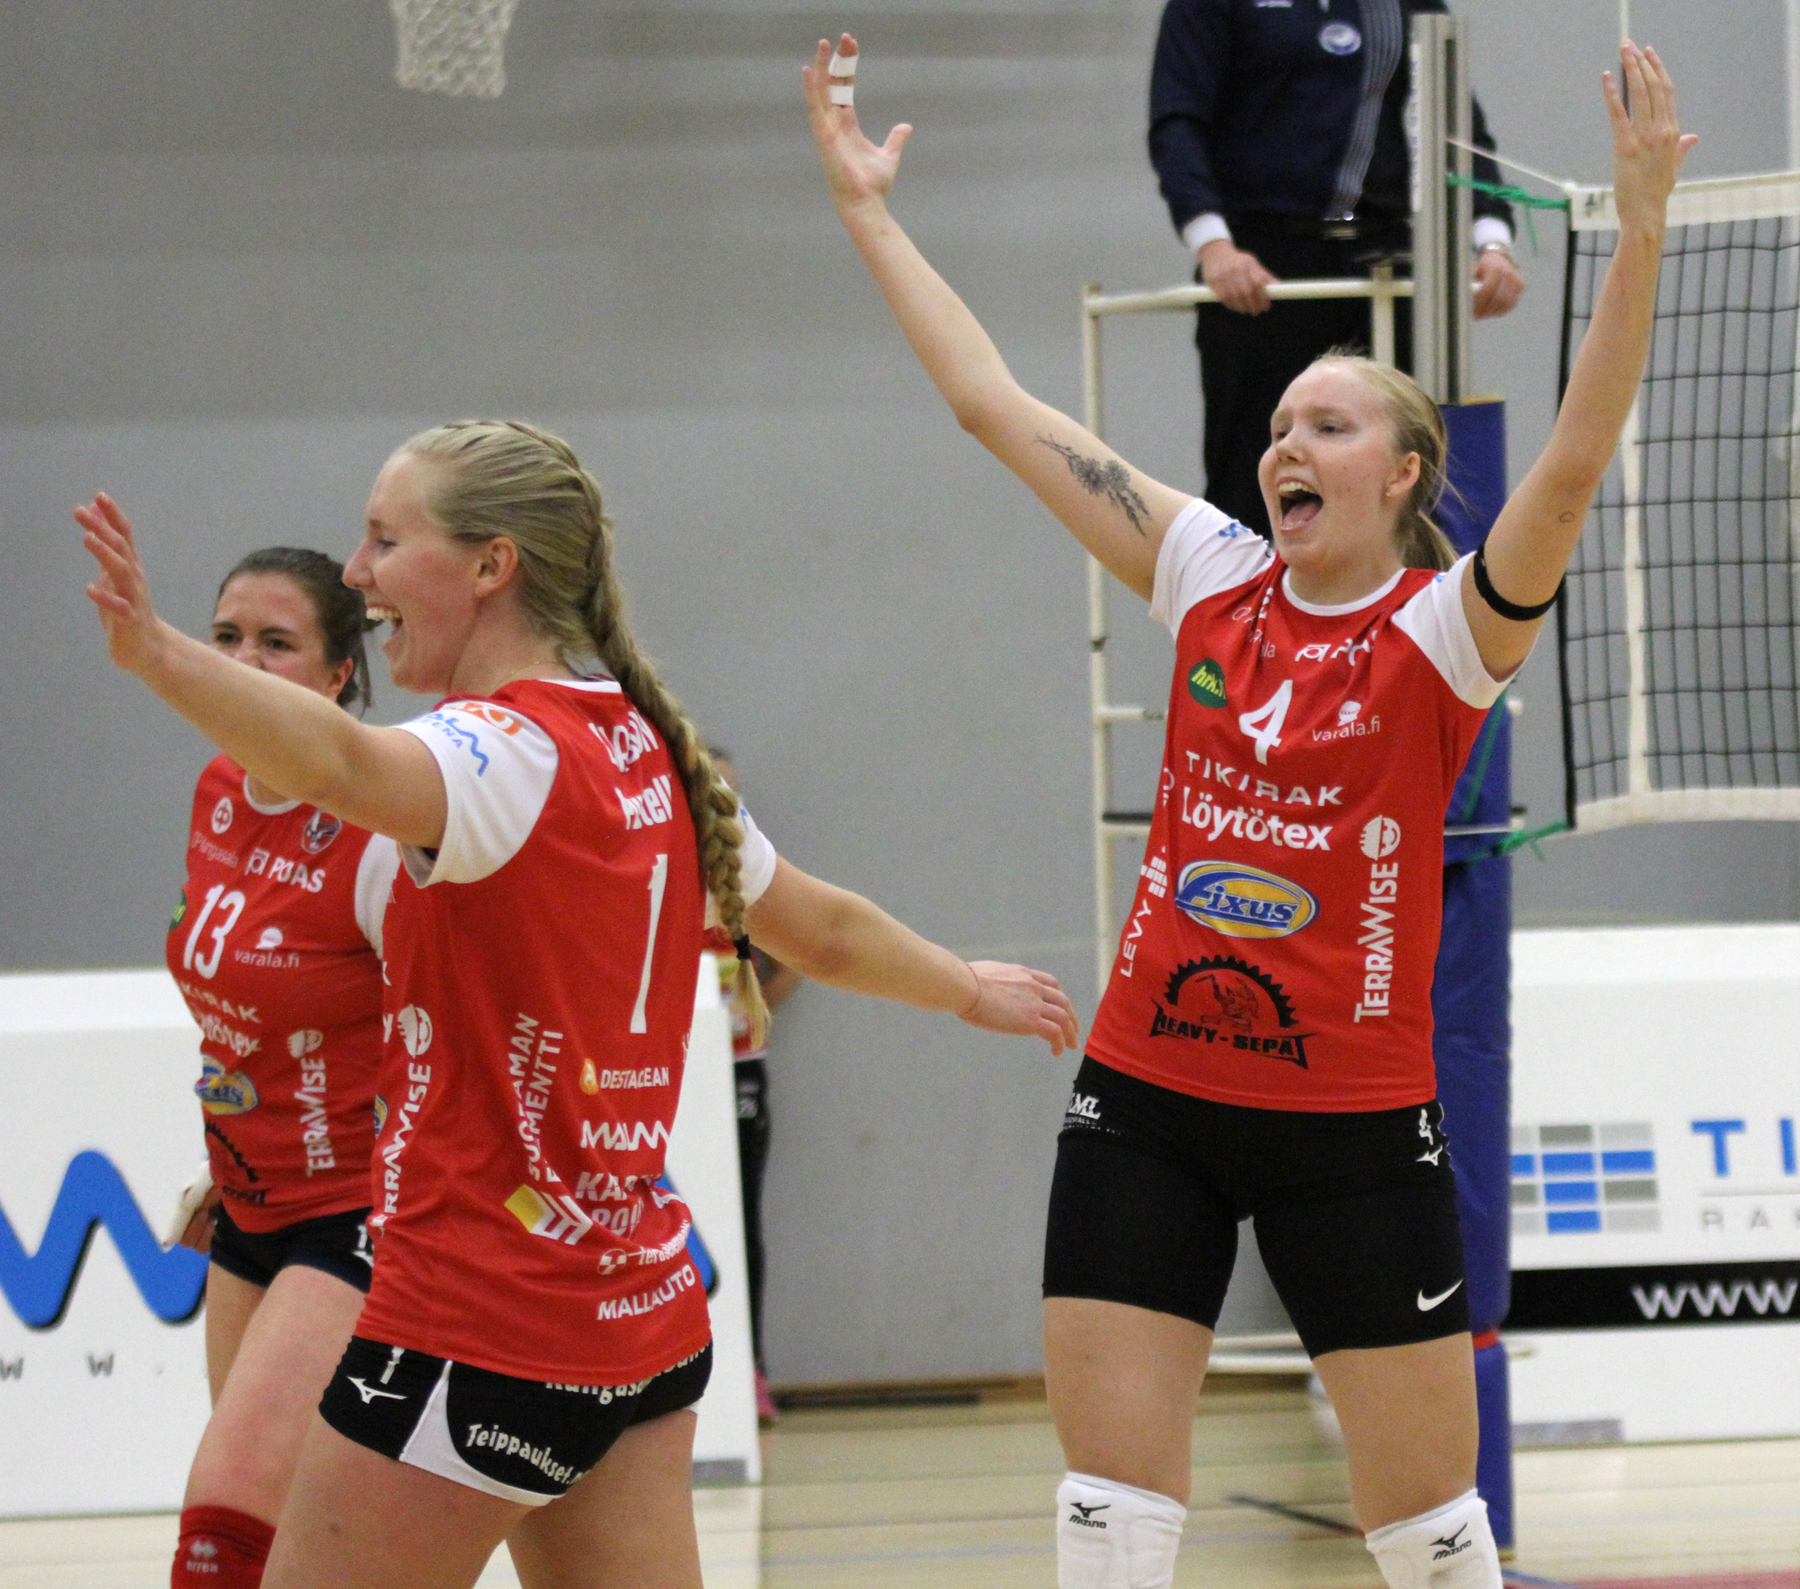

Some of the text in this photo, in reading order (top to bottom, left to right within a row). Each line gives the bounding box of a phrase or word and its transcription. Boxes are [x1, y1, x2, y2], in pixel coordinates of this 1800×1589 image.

[1239, 679, 1293, 765] 4
[1312, 715, 1381, 742] varala.fi
[1185, 750, 1343, 806] TIKIRAK
[1181, 786, 1333, 852] Löytötex
[183, 884, 246, 979] 13
[234, 949, 300, 968] varala.fi
[629, 853, 668, 1034] 1
[1702, 1206, 1800, 1233] RA
[597, 1264, 695, 1321] MALLAUTO
